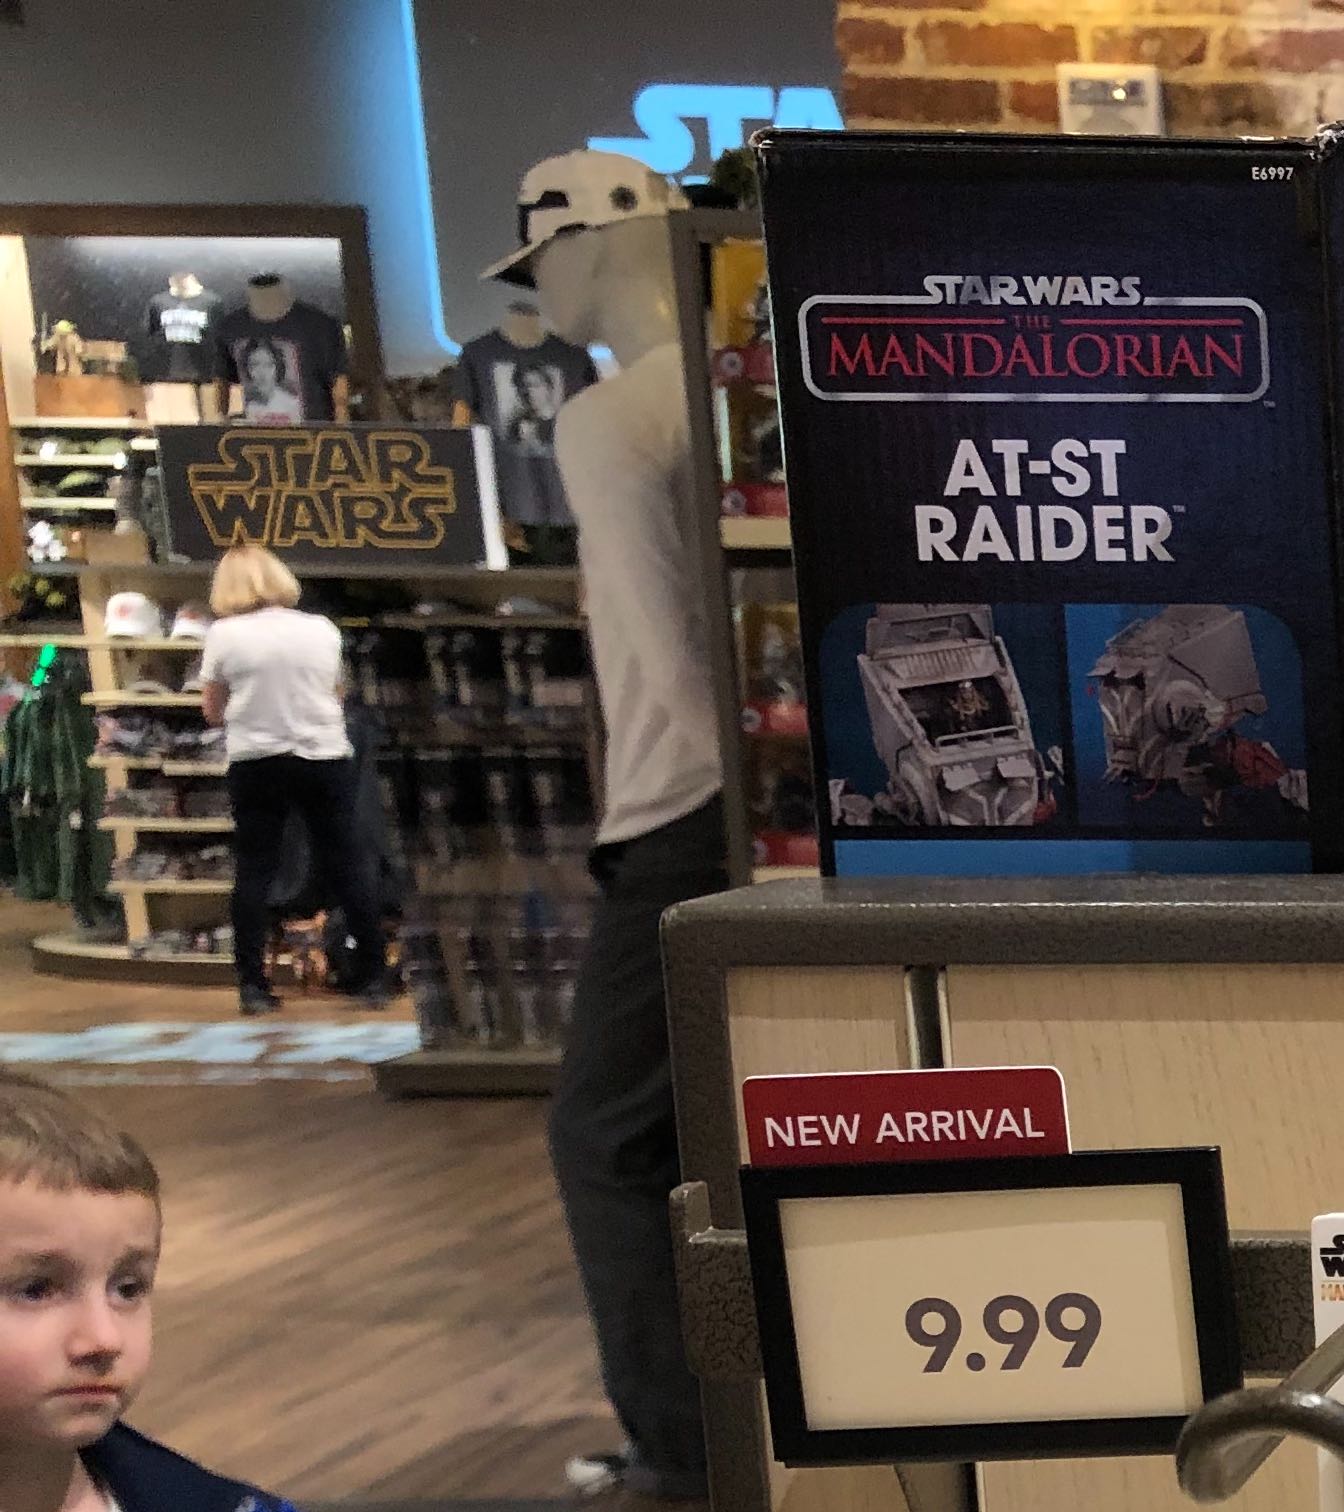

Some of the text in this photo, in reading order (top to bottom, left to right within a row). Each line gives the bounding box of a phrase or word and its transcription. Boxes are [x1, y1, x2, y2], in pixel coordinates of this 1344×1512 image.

[1252, 166, 1294, 180] E6997
[923, 275, 1141, 305] STAR WARS
[1011, 315, 1051, 328] THE
[827, 332, 1243, 378] MANDALORIAN
[188, 430, 454, 491] STAR
[943, 438, 1127, 497] AT-ST
[191, 487, 456, 549] WARS
[764, 1107, 1045, 1147] NEW ARRIVAL
[905, 1292, 1102, 1373] 9.99
